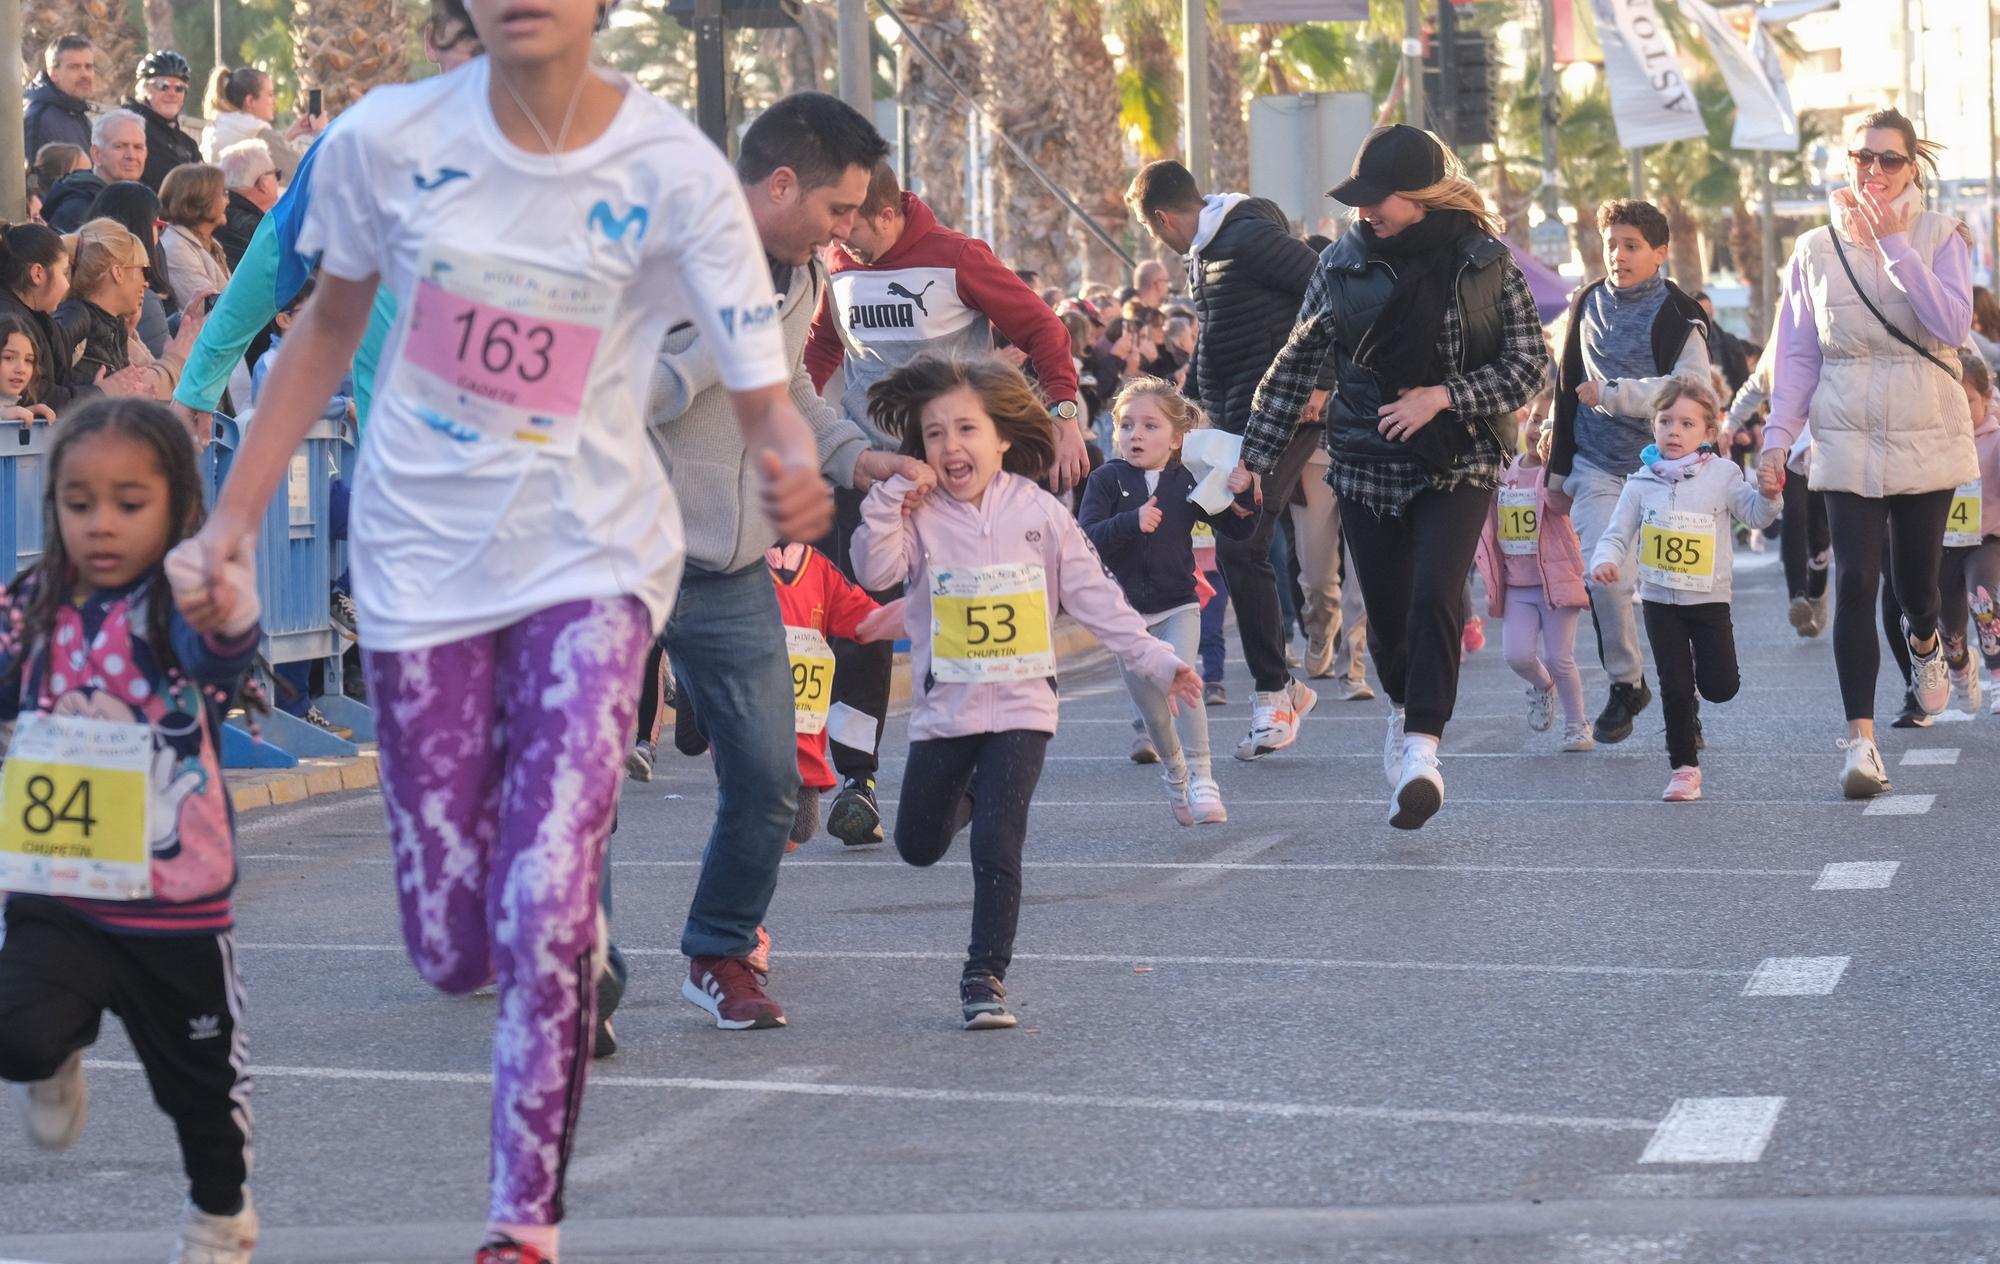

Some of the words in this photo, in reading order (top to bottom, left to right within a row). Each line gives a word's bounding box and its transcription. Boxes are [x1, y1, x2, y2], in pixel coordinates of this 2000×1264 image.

[849, 304, 914, 329] PUMA
[454, 308, 555, 383] 163
[1653, 534, 1701, 565] 185
[966, 604, 1017, 644] 53
[23, 774, 96, 837] 84
